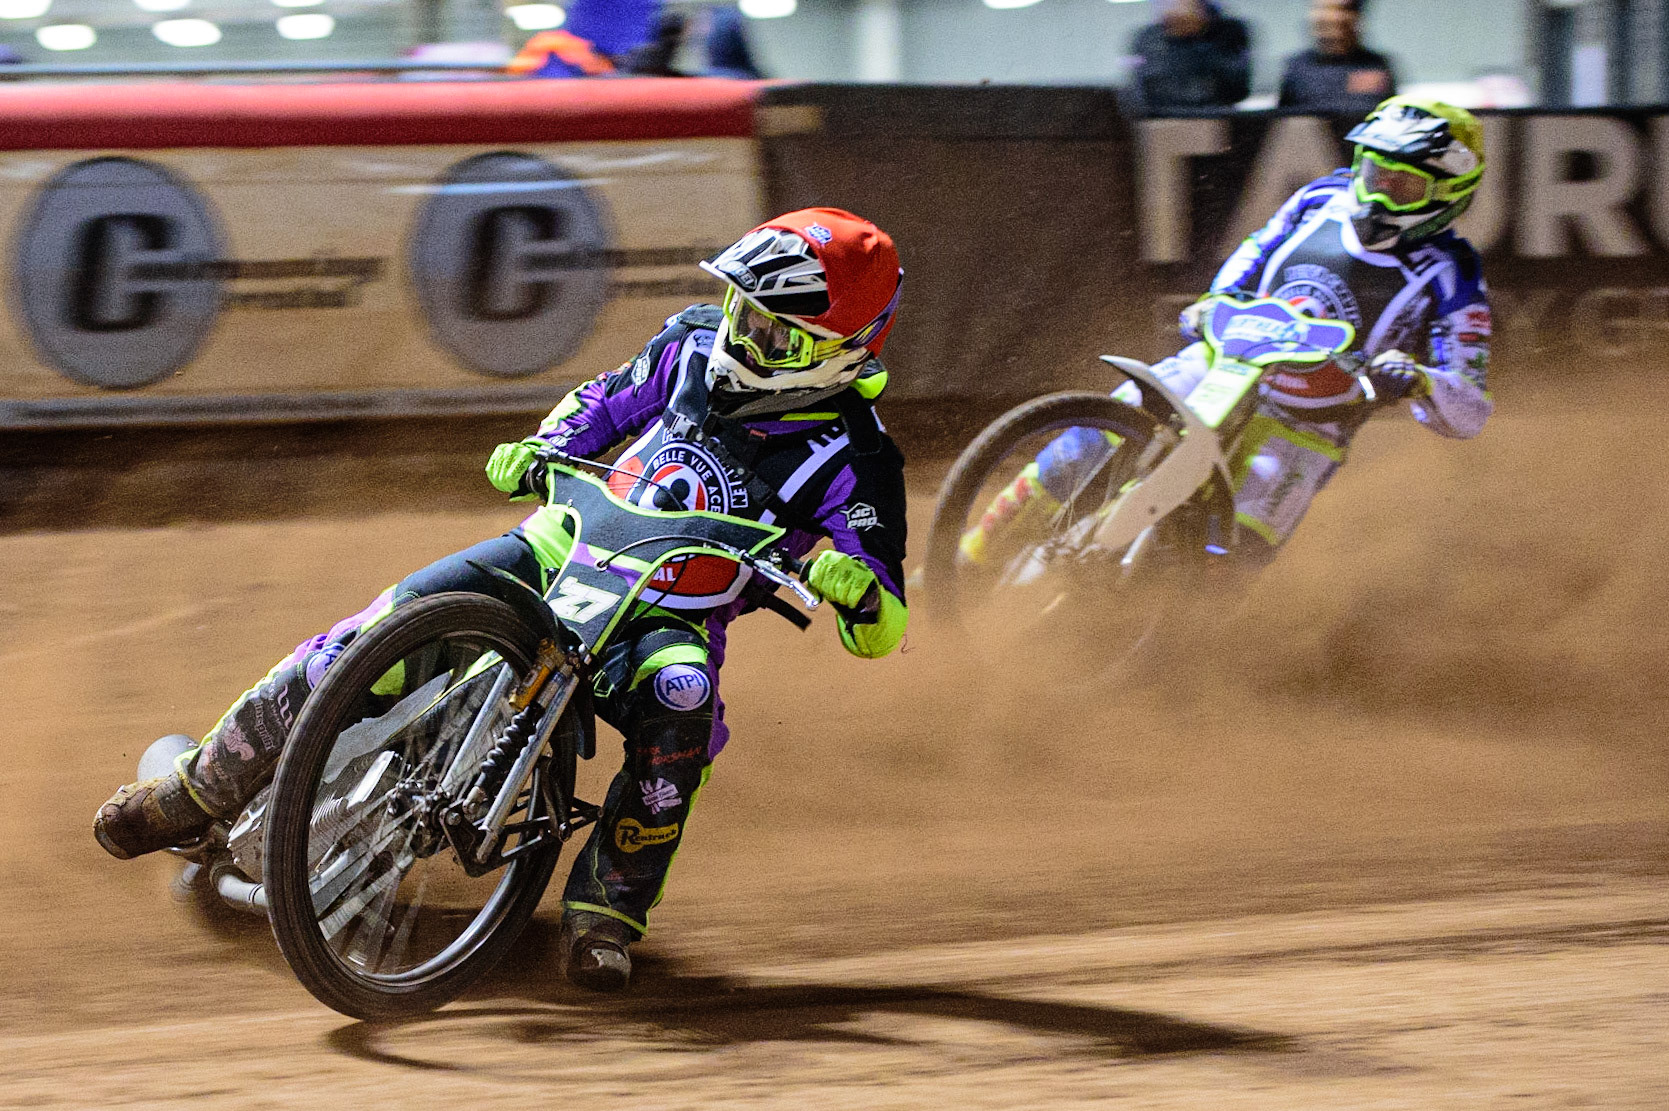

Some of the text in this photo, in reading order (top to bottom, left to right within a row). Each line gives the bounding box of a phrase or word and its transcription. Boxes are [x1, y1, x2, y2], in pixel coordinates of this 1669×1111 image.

[652, 450, 686, 470] BELLE
[690, 456, 713, 481] VUE
[665, 674, 702, 696] ATPI
